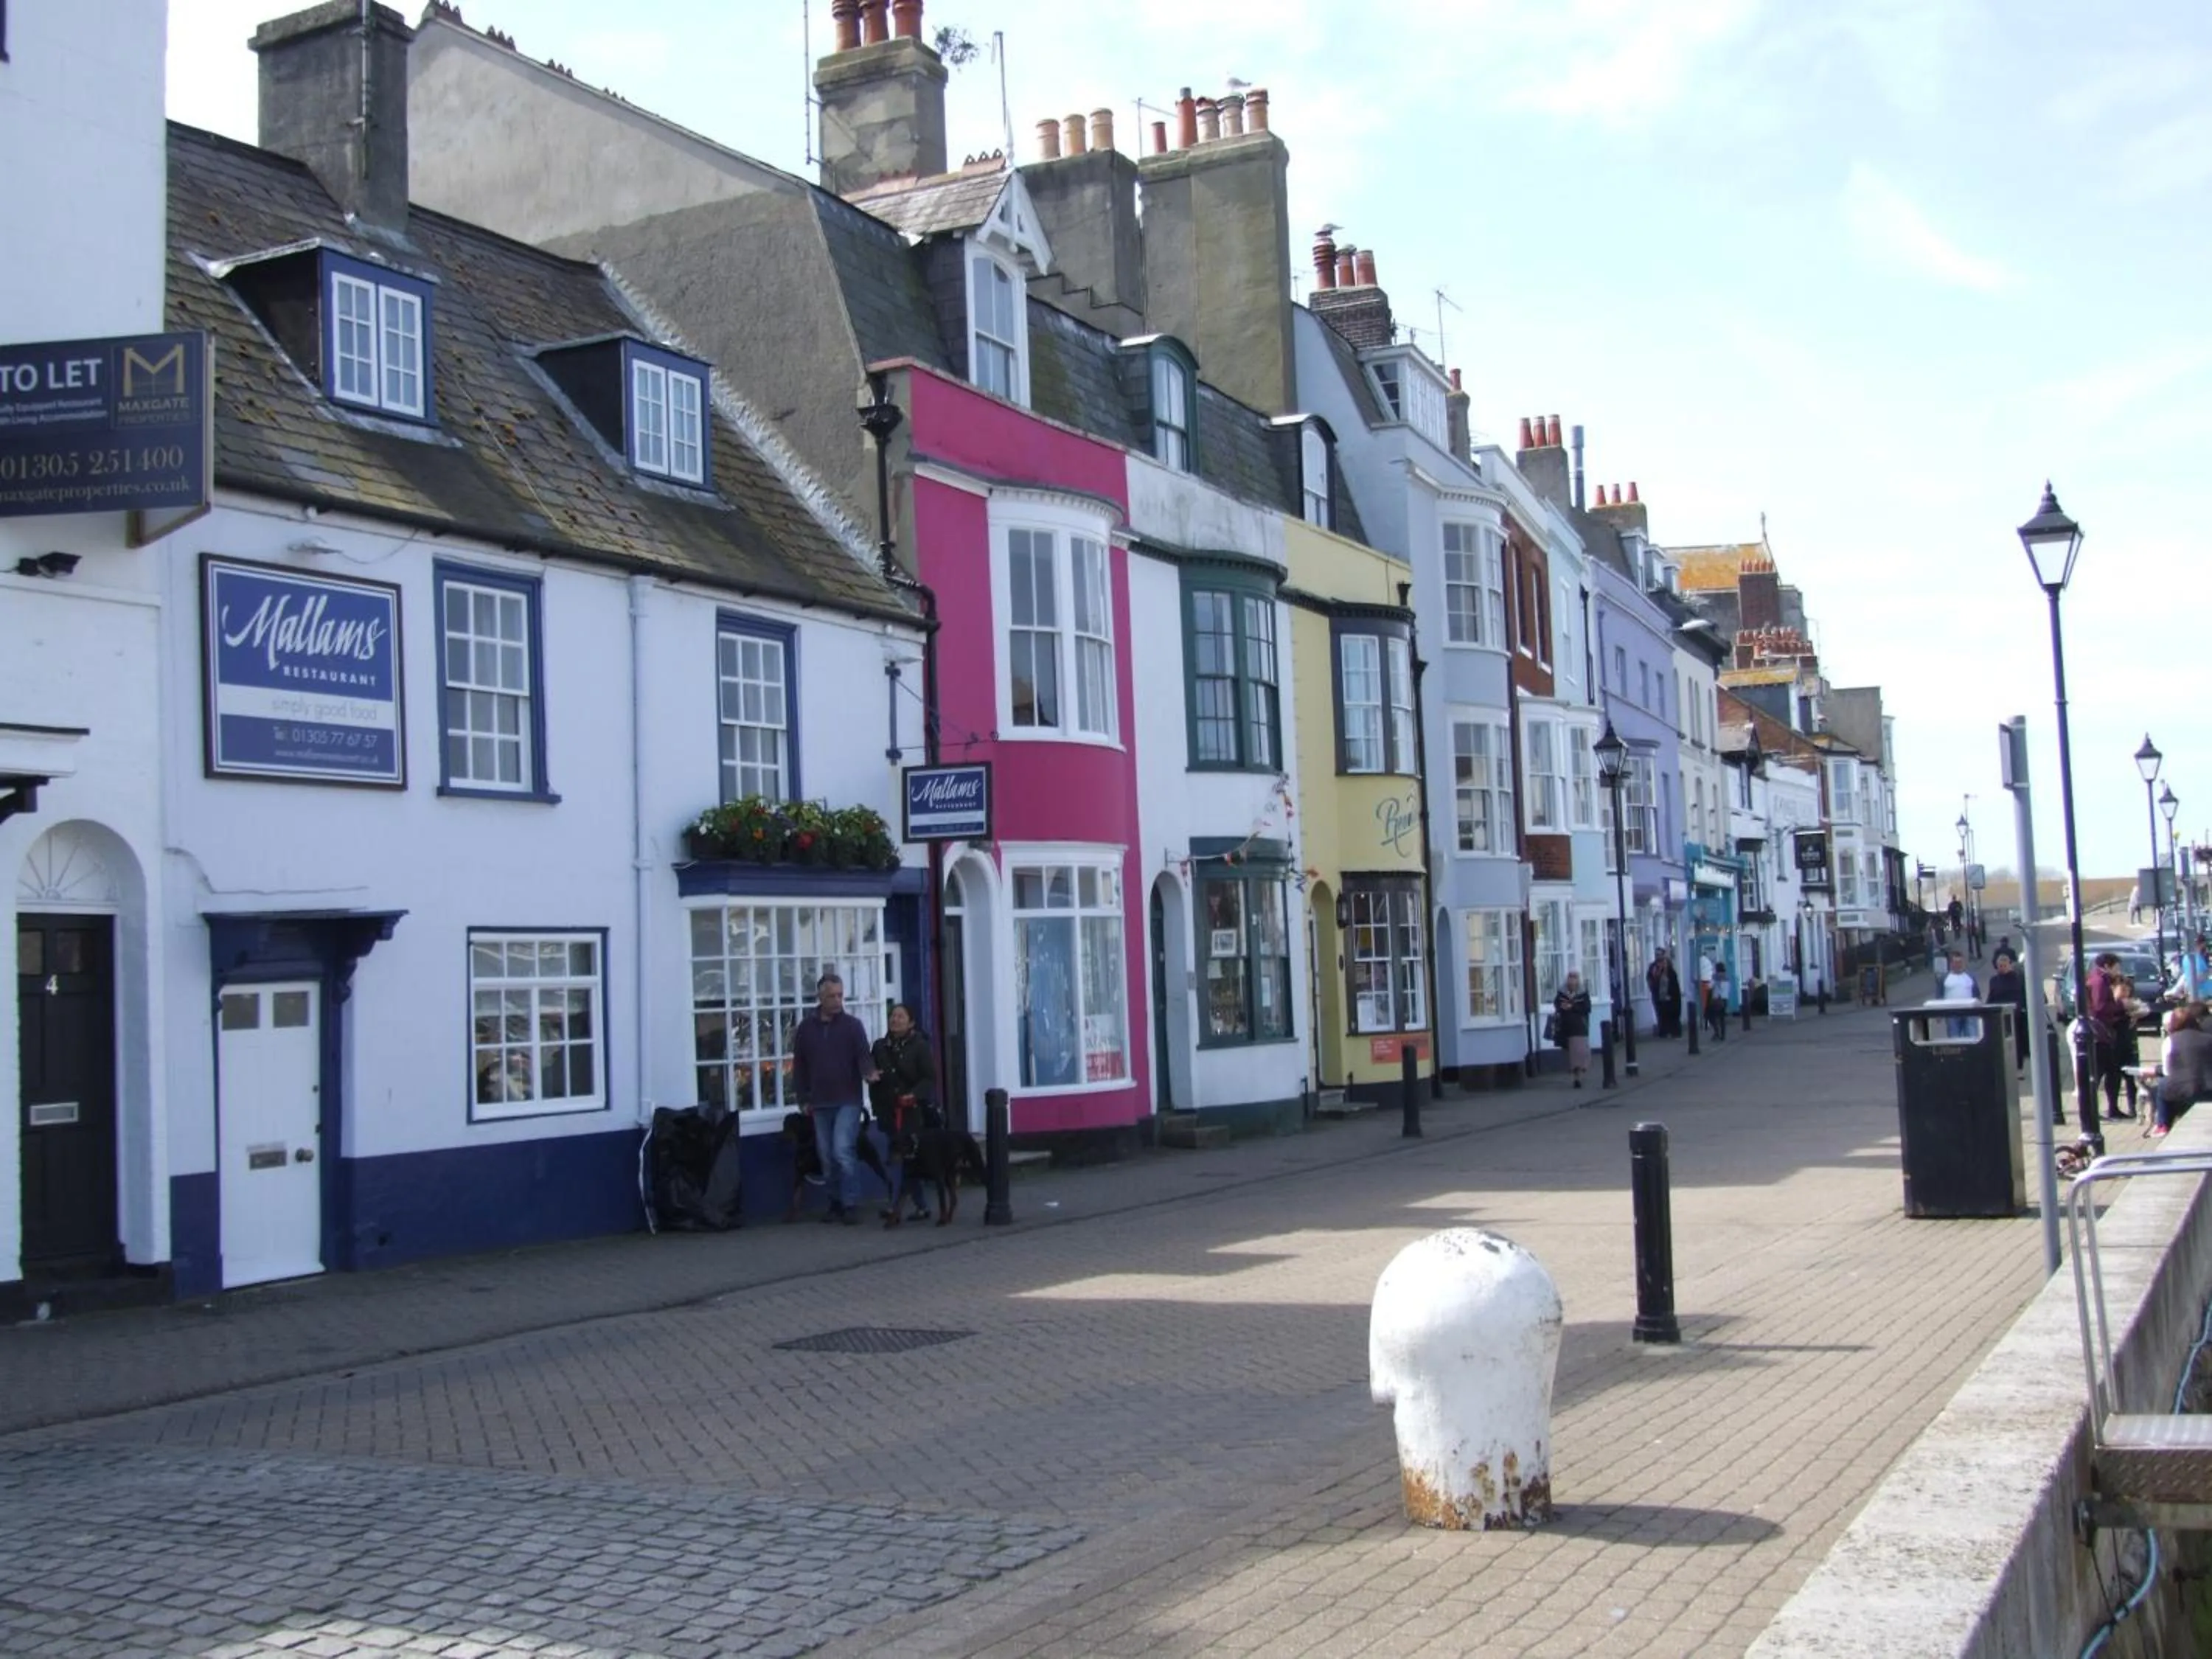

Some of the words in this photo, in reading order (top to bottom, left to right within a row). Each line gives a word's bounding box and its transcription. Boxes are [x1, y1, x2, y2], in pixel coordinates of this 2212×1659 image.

[0, 364, 38, 393] TO
[47, 358, 103, 390] LET
[118, 397, 190, 414] MAXGATE
[1, 451, 79, 480] 01305
[221, 593, 387, 671] Mallams
[282, 665, 376, 687] RESTAURANT
[314, 700, 347, 720] good
[911, 774, 982, 809] Mallams
[45, 974, 59, 995] 4
